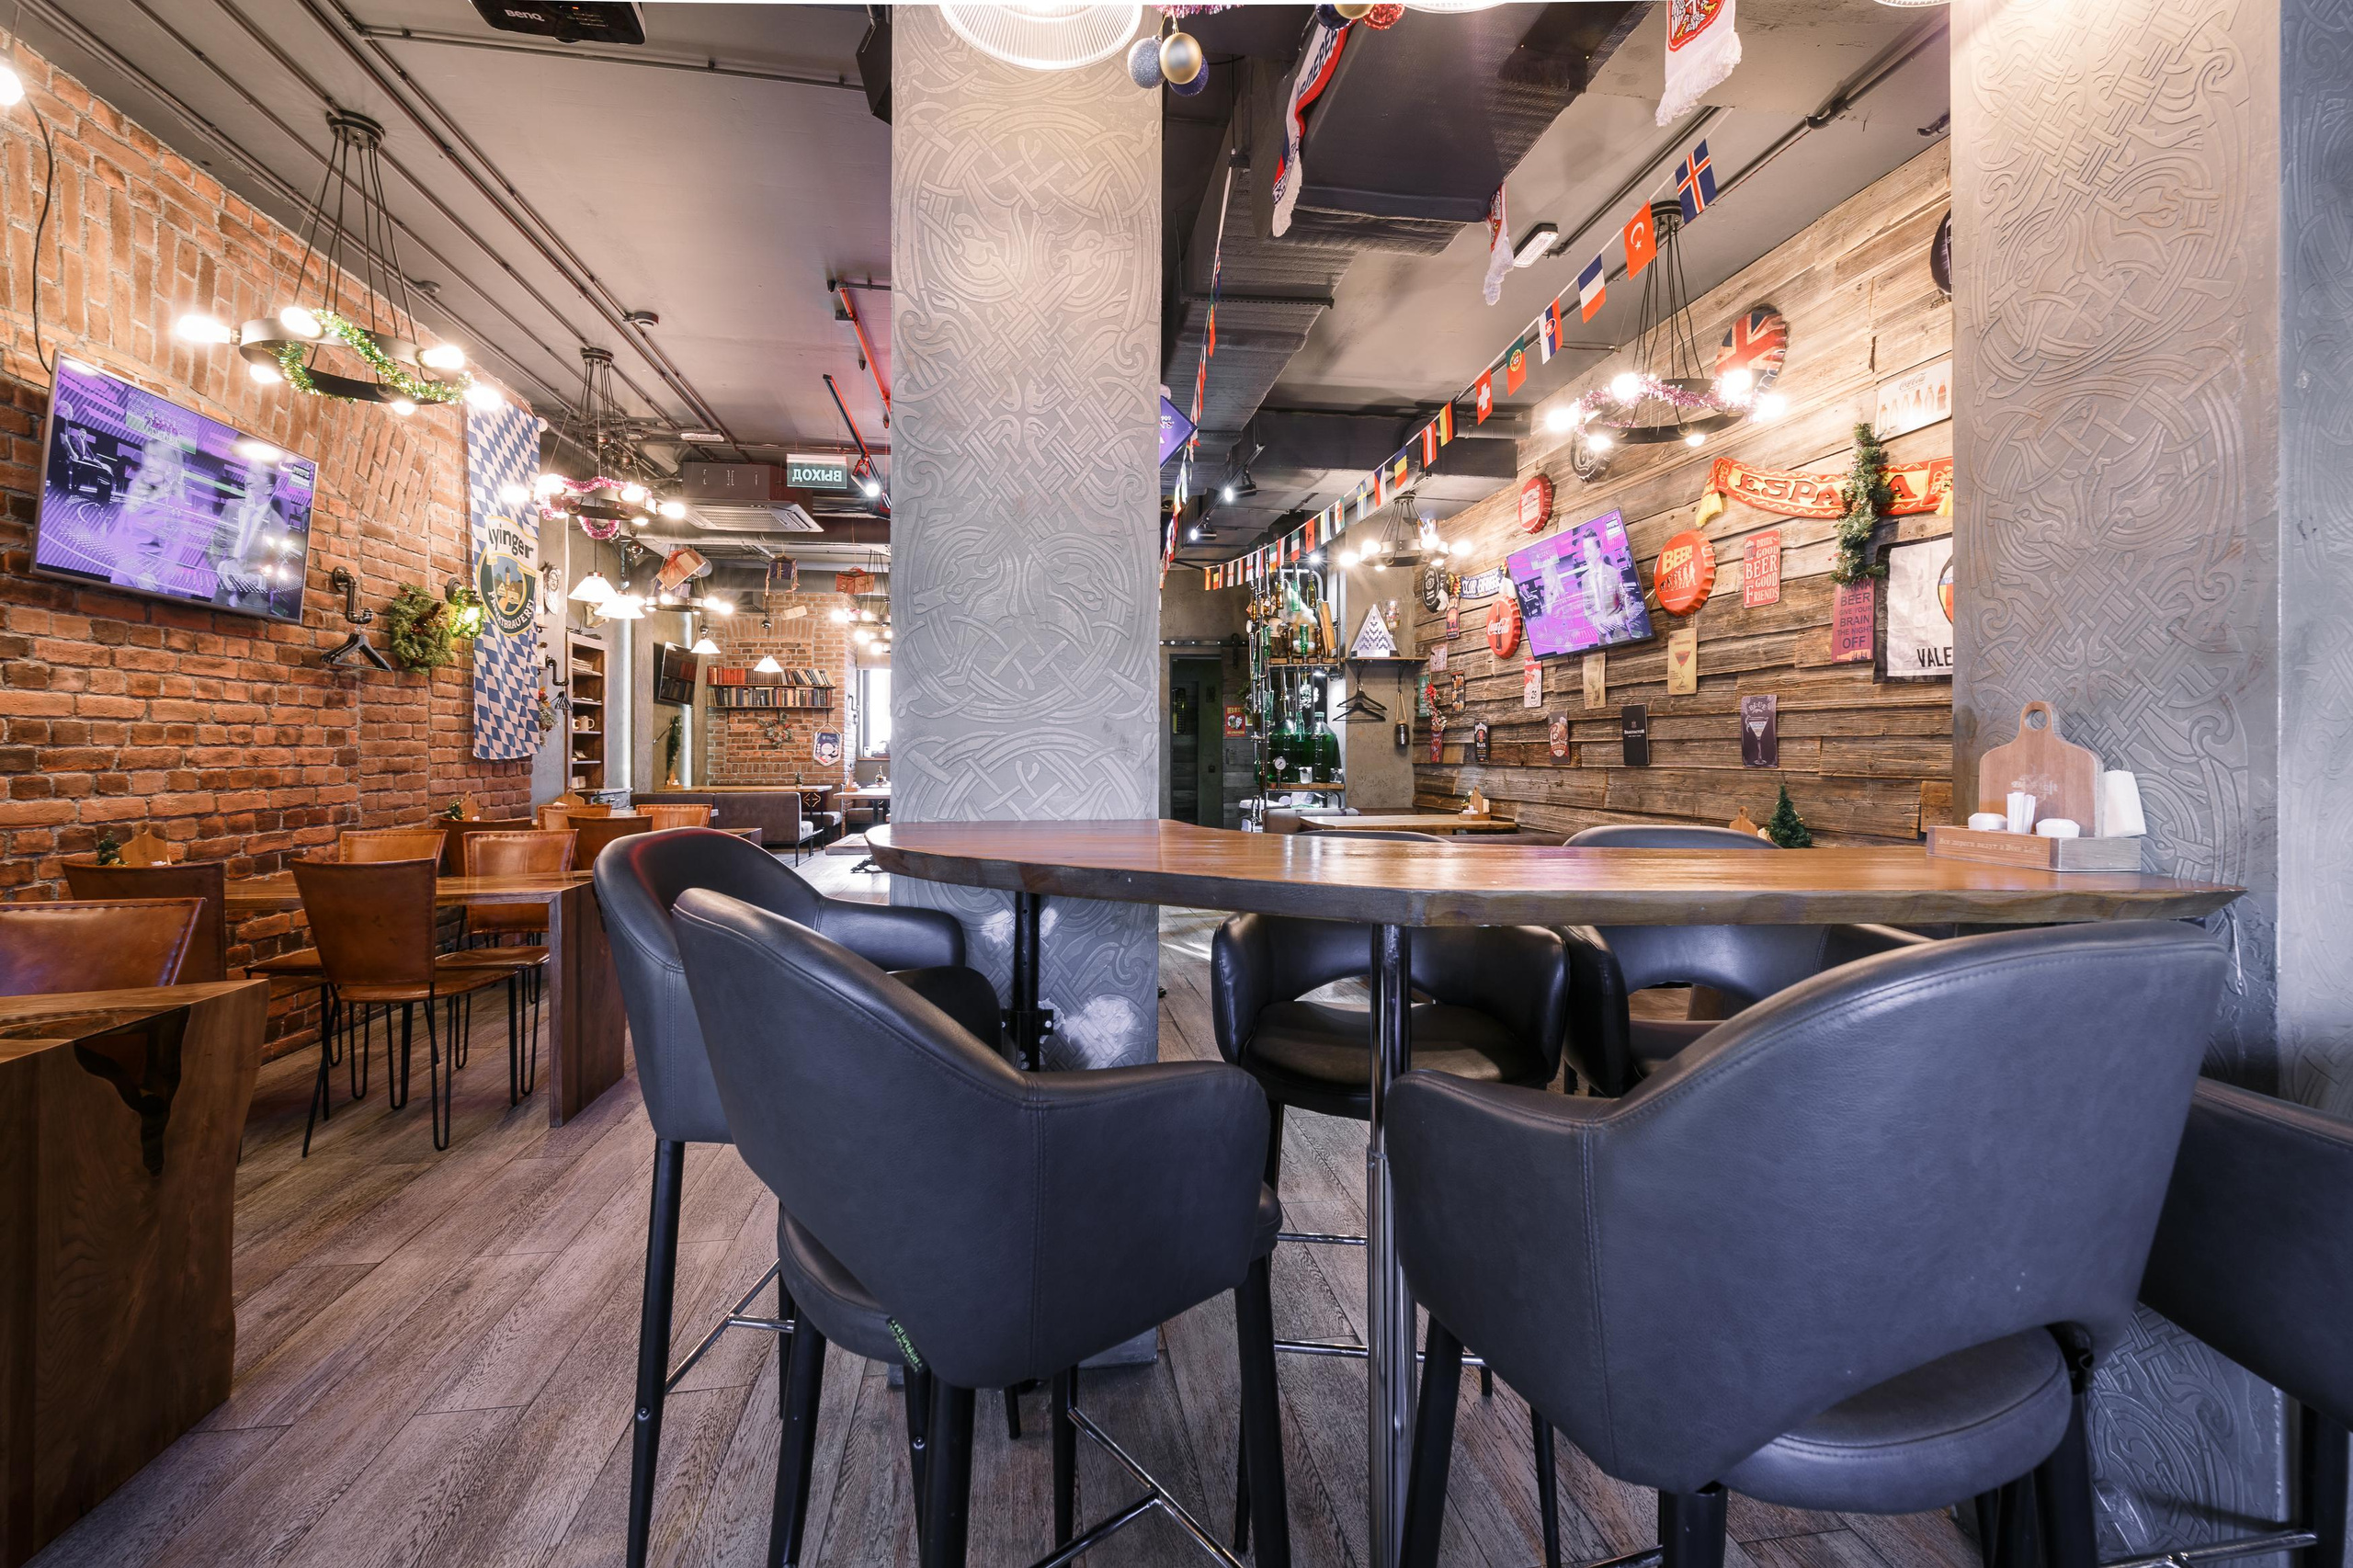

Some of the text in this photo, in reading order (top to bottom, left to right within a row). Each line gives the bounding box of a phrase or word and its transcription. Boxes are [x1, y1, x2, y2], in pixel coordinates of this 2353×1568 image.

[505, 9, 545, 22] BenQ
[1735, 472, 1918, 506] ESPAA
[1756, 545, 1779, 559] GOOD
[1662, 544, 1693, 575] BEER!
[1745, 555, 1779, 580] BEER
[1755, 572, 1778, 588] GOOD
[1745, 585, 1779, 604] FRIENDS
[1840, 592, 1870, 607] BEER
[1839, 605, 1872, 616] GIVE YOUR
[1487, 617, 1510, 637] Coca-Cola
[1840, 615, 1870, 628] BRAIN
[1837, 625, 1873, 637] THE NIGHT
[1842, 635, 1867, 649] OFF
[1748, 701, 1768, 711] BLUE
